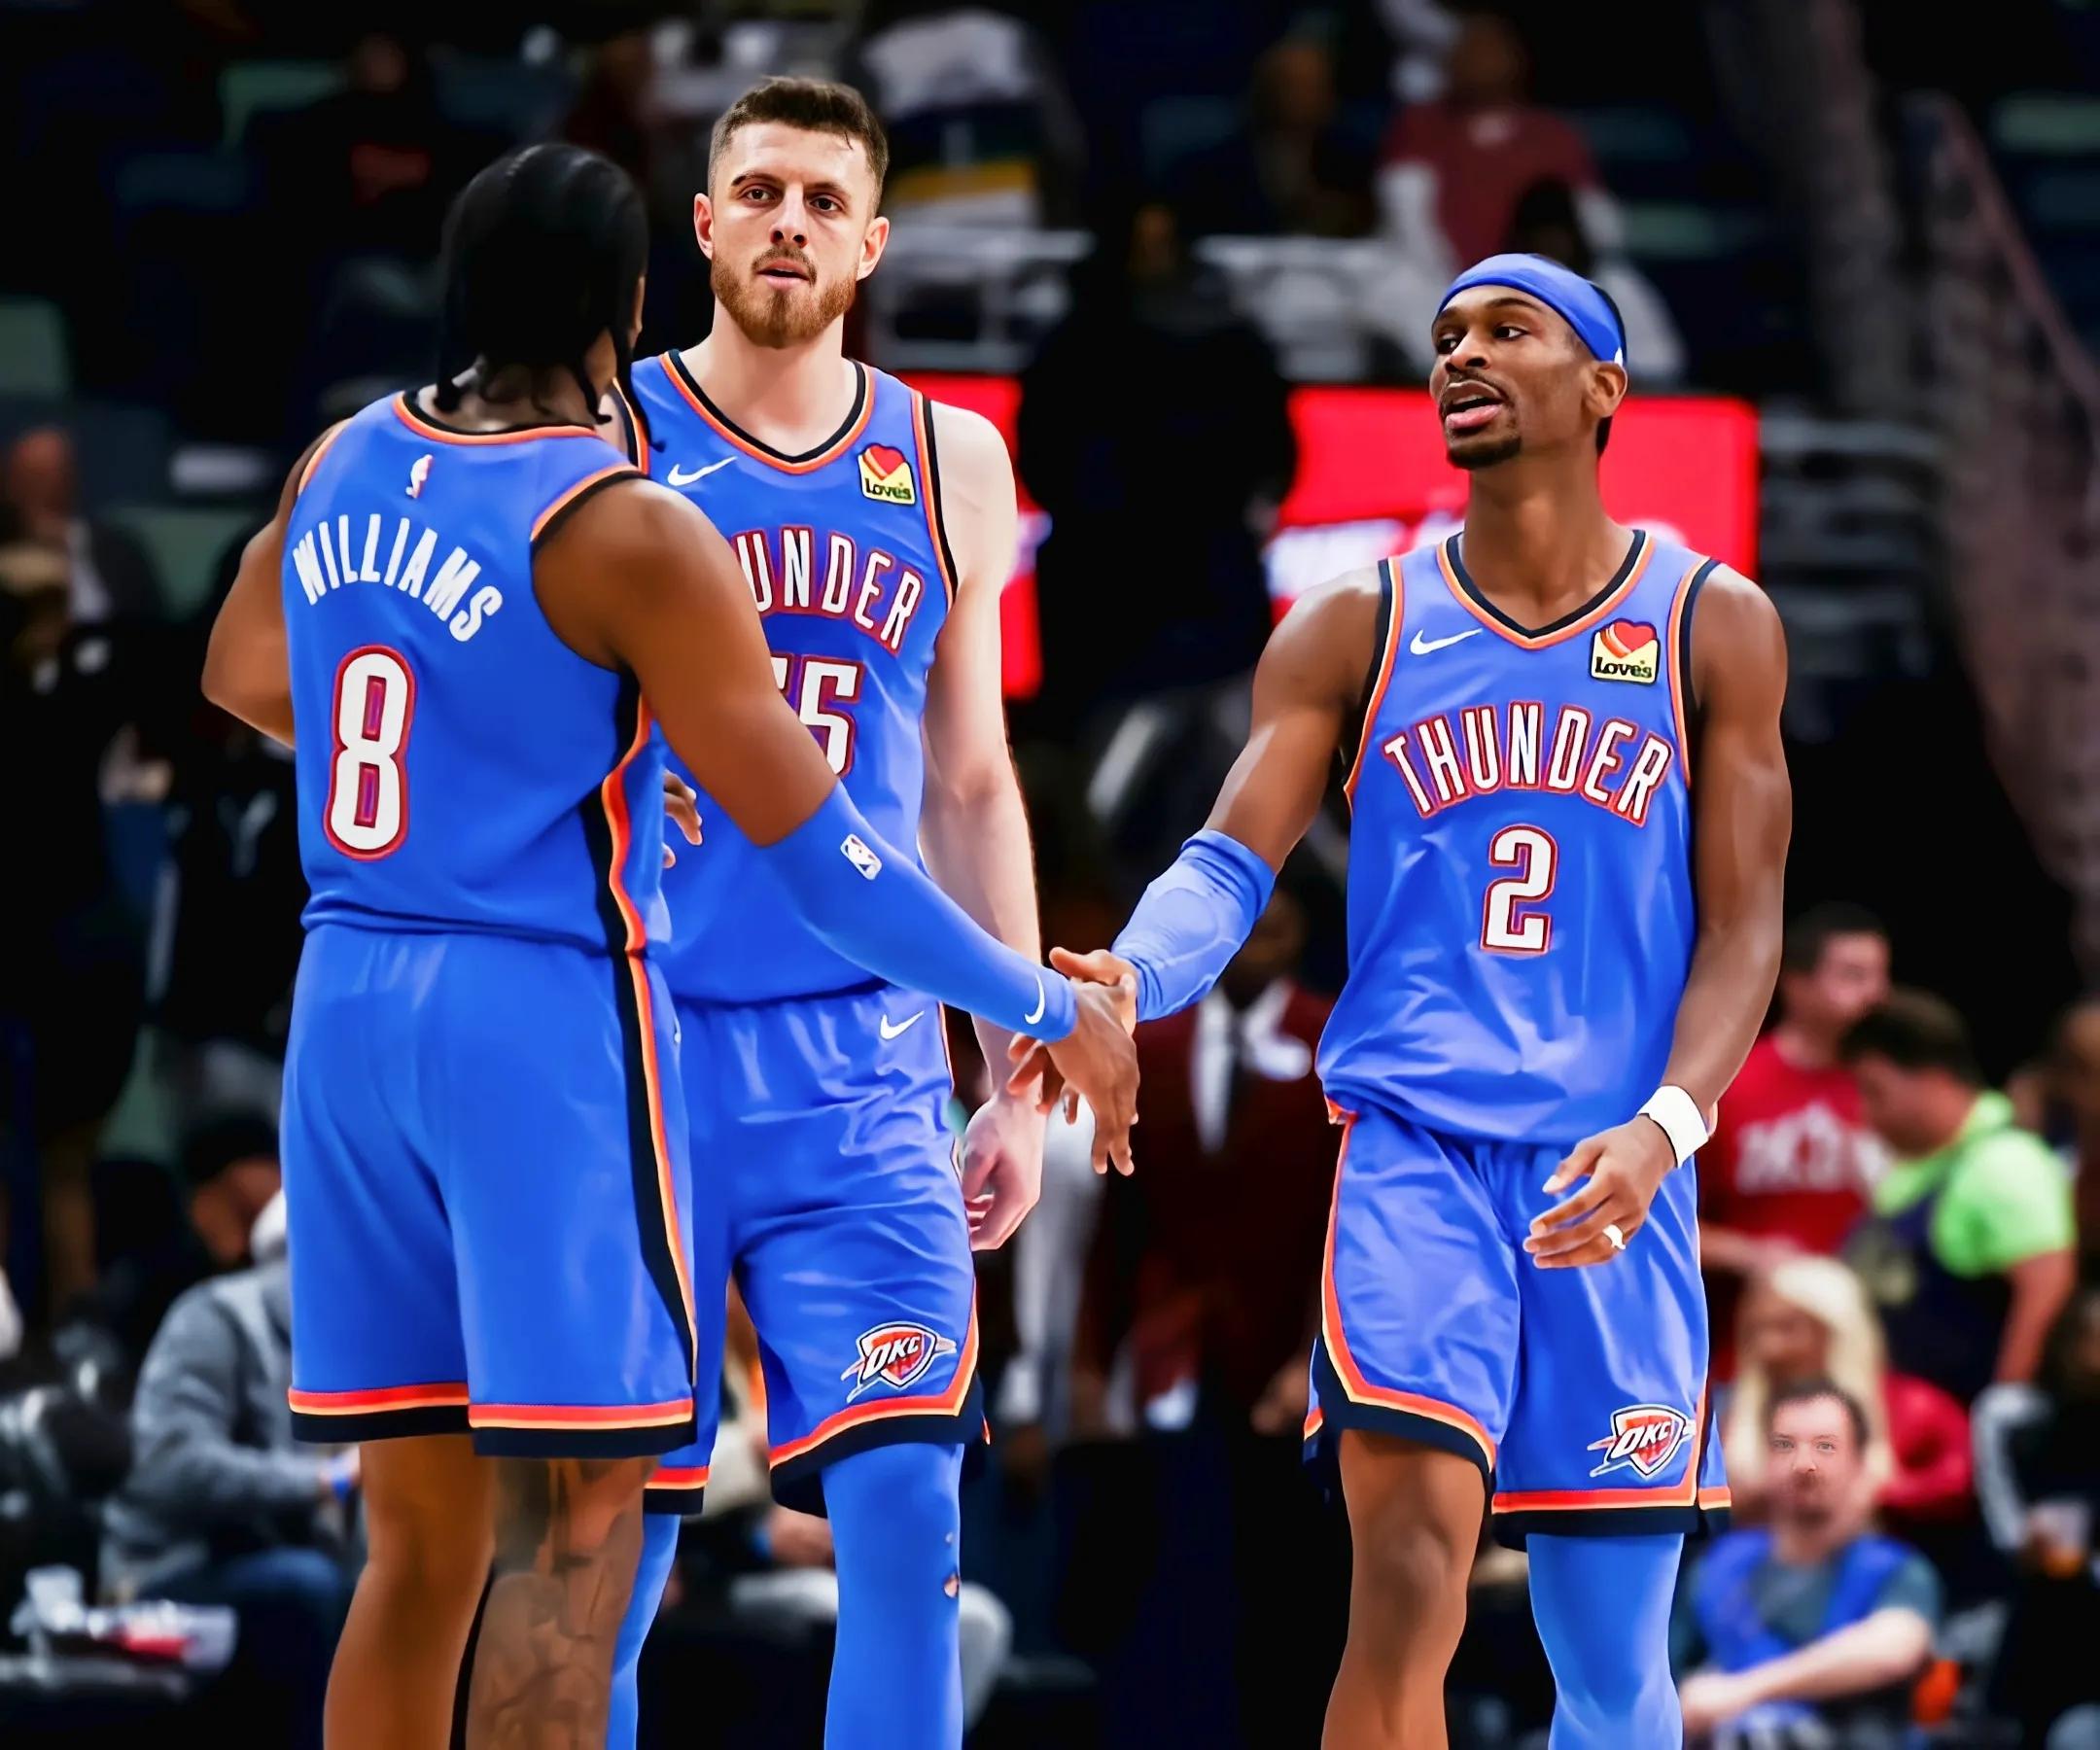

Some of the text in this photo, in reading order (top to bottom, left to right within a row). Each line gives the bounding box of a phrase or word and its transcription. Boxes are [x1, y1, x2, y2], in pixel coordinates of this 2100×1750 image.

[293, 513, 503, 642] WILLIAMS
[731, 525, 924, 656] UNDER
[770, 652, 863, 777] 5
[1594, 656, 1653, 679] Love's
[323, 644, 416, 861] 8
[1382, 701, 1674, 826] THUNDER
[1480, 824, 1558, 953] 2
[862, 1336, 922, 1381] OKC
[1610, 1420, 1671, 1459] OKC
